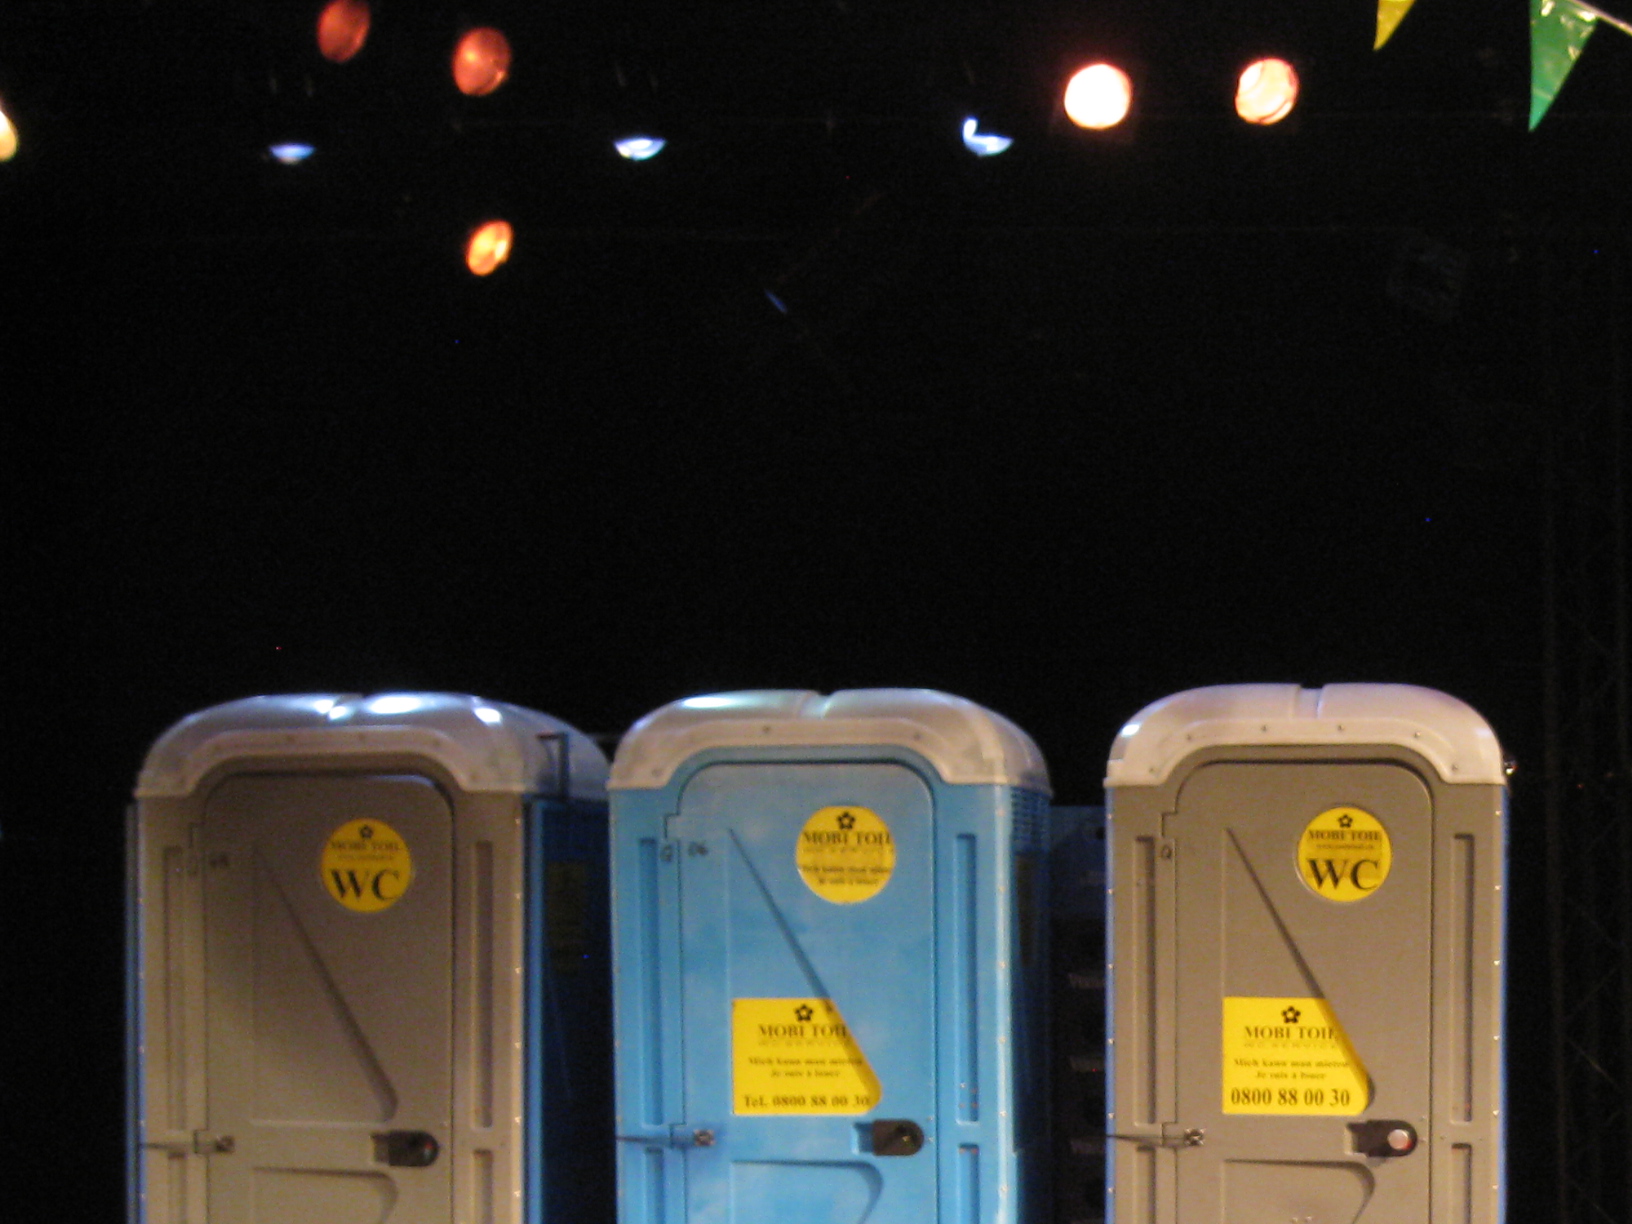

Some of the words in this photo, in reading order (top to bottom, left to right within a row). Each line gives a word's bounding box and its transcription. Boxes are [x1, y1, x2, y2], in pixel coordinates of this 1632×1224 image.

[803, 831, 848, 846] MOBI
[1308, 830, 1345, 841] MOBI
[1306, 858, 1379, 891] WC
[330, 868, 400, 901] WC
[758, 1024, 805, 1039] MOBI
[1245, 1026, 1291, 1040] MOBI
[772, 1095, 807, 1108] 0800
[831, 1095, 848, 1108] 00
[1231, 1087, 1272, 1107] 0800
[1277, 1088, 1298, 1107] 88
[1303, 1088, 1324, 1107] 00
[1329, 1088, 1351, 1107] 30
